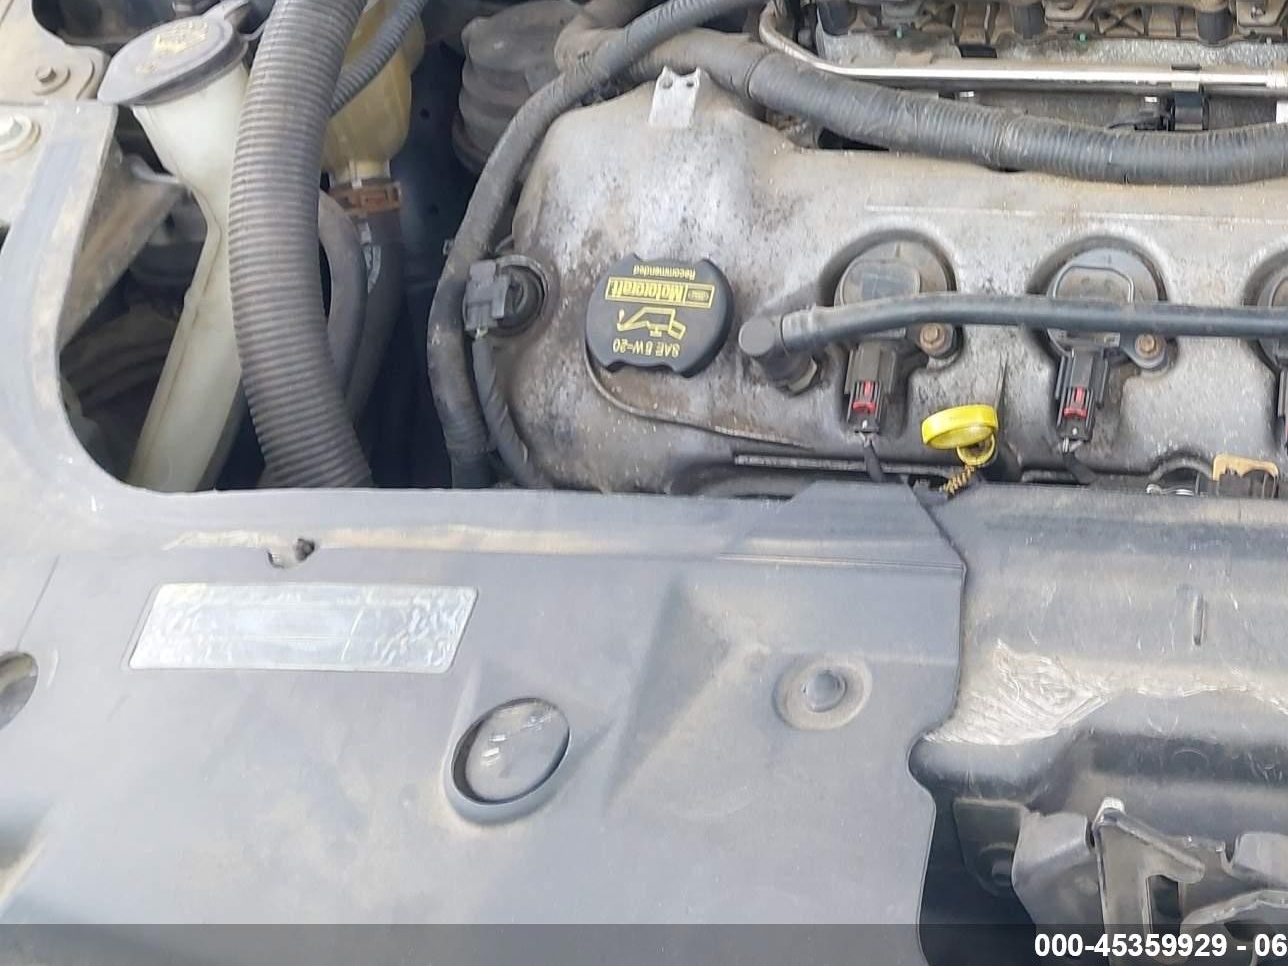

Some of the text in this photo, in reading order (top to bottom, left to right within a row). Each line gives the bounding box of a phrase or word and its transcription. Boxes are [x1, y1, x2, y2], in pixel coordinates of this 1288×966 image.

[633, 265, 696, 281] Recommended
[611, 281, 684, 302] Motorcraft
[655, 341, 681, 358] SAE
